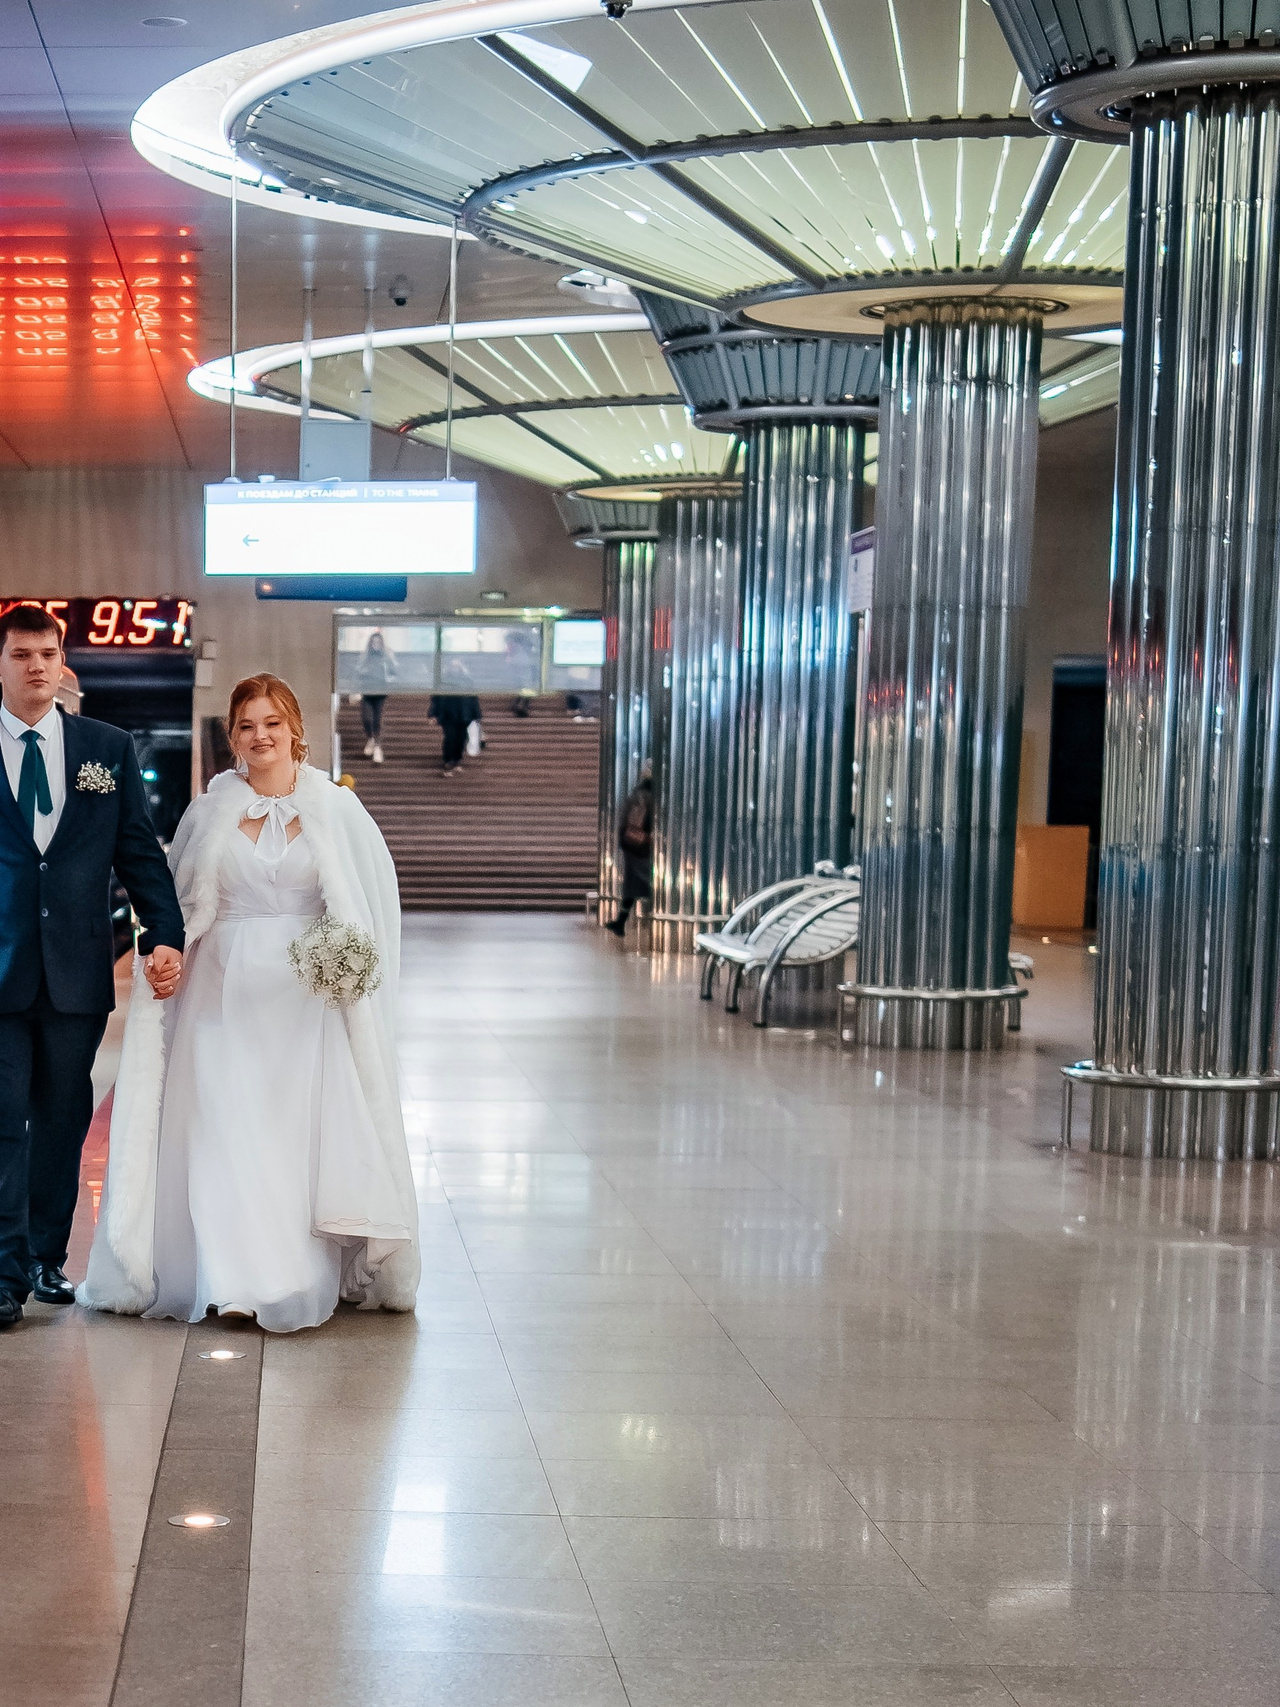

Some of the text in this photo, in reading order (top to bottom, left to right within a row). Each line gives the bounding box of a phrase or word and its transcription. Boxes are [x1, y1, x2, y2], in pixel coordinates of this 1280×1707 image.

[246, 490, 293, 499] ПОЕЗДАМ
[294, 490, 308, 499] ДО
[372, 489, 439, 498] TO THE TRAINS
